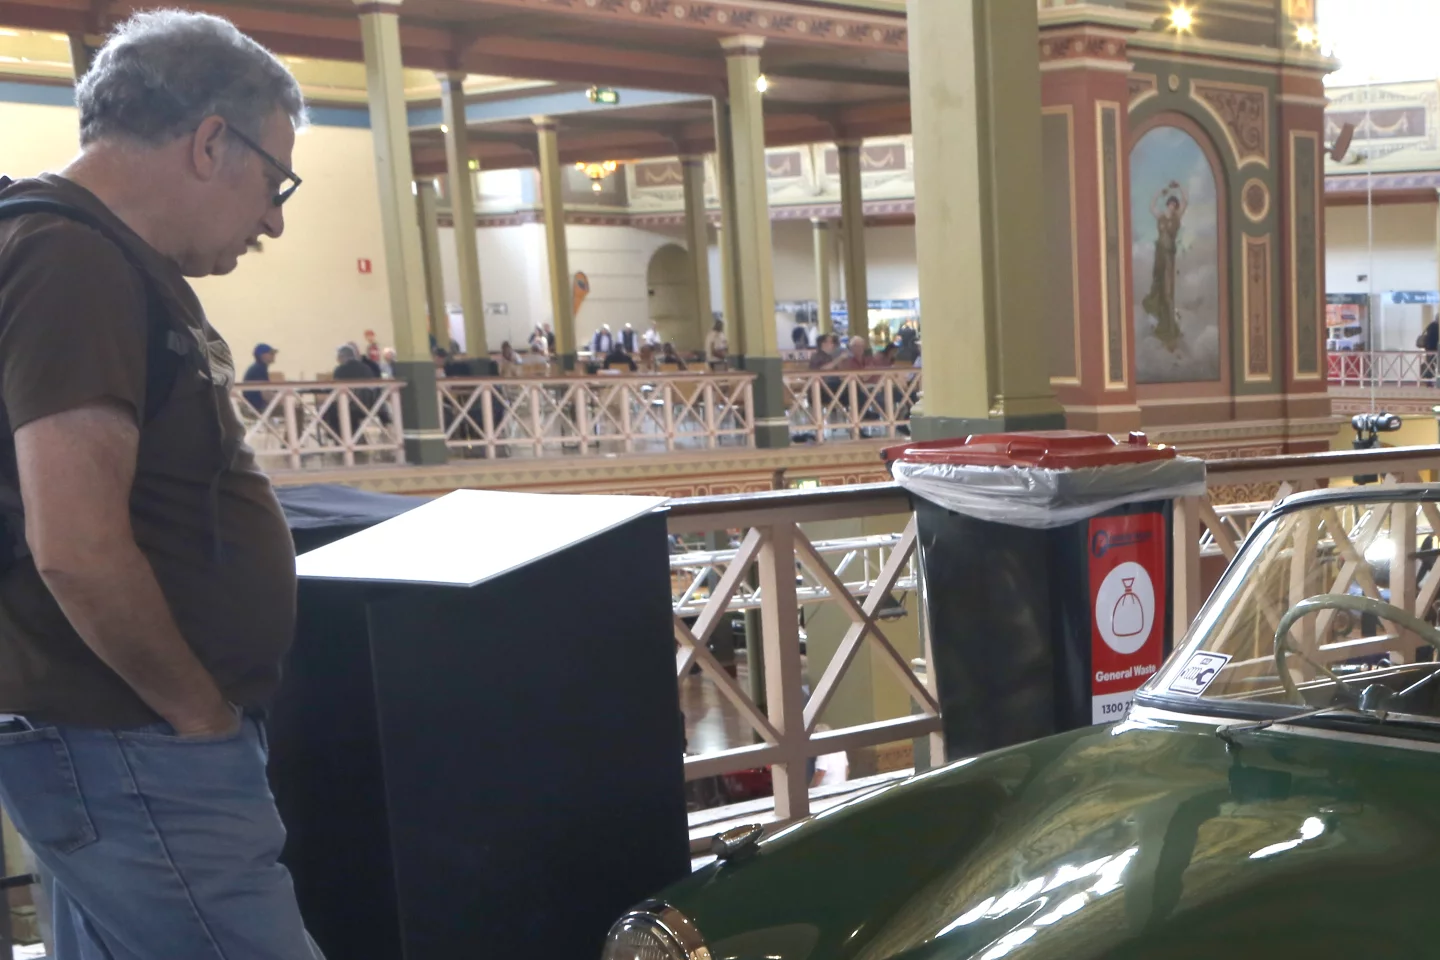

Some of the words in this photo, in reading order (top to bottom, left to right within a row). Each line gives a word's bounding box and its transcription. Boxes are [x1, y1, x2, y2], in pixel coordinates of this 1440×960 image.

[1095, 666, 1133, 682] General
[1133, 664, 1157, 677] Waste
[1102, 701, 1124, 714] 1300
